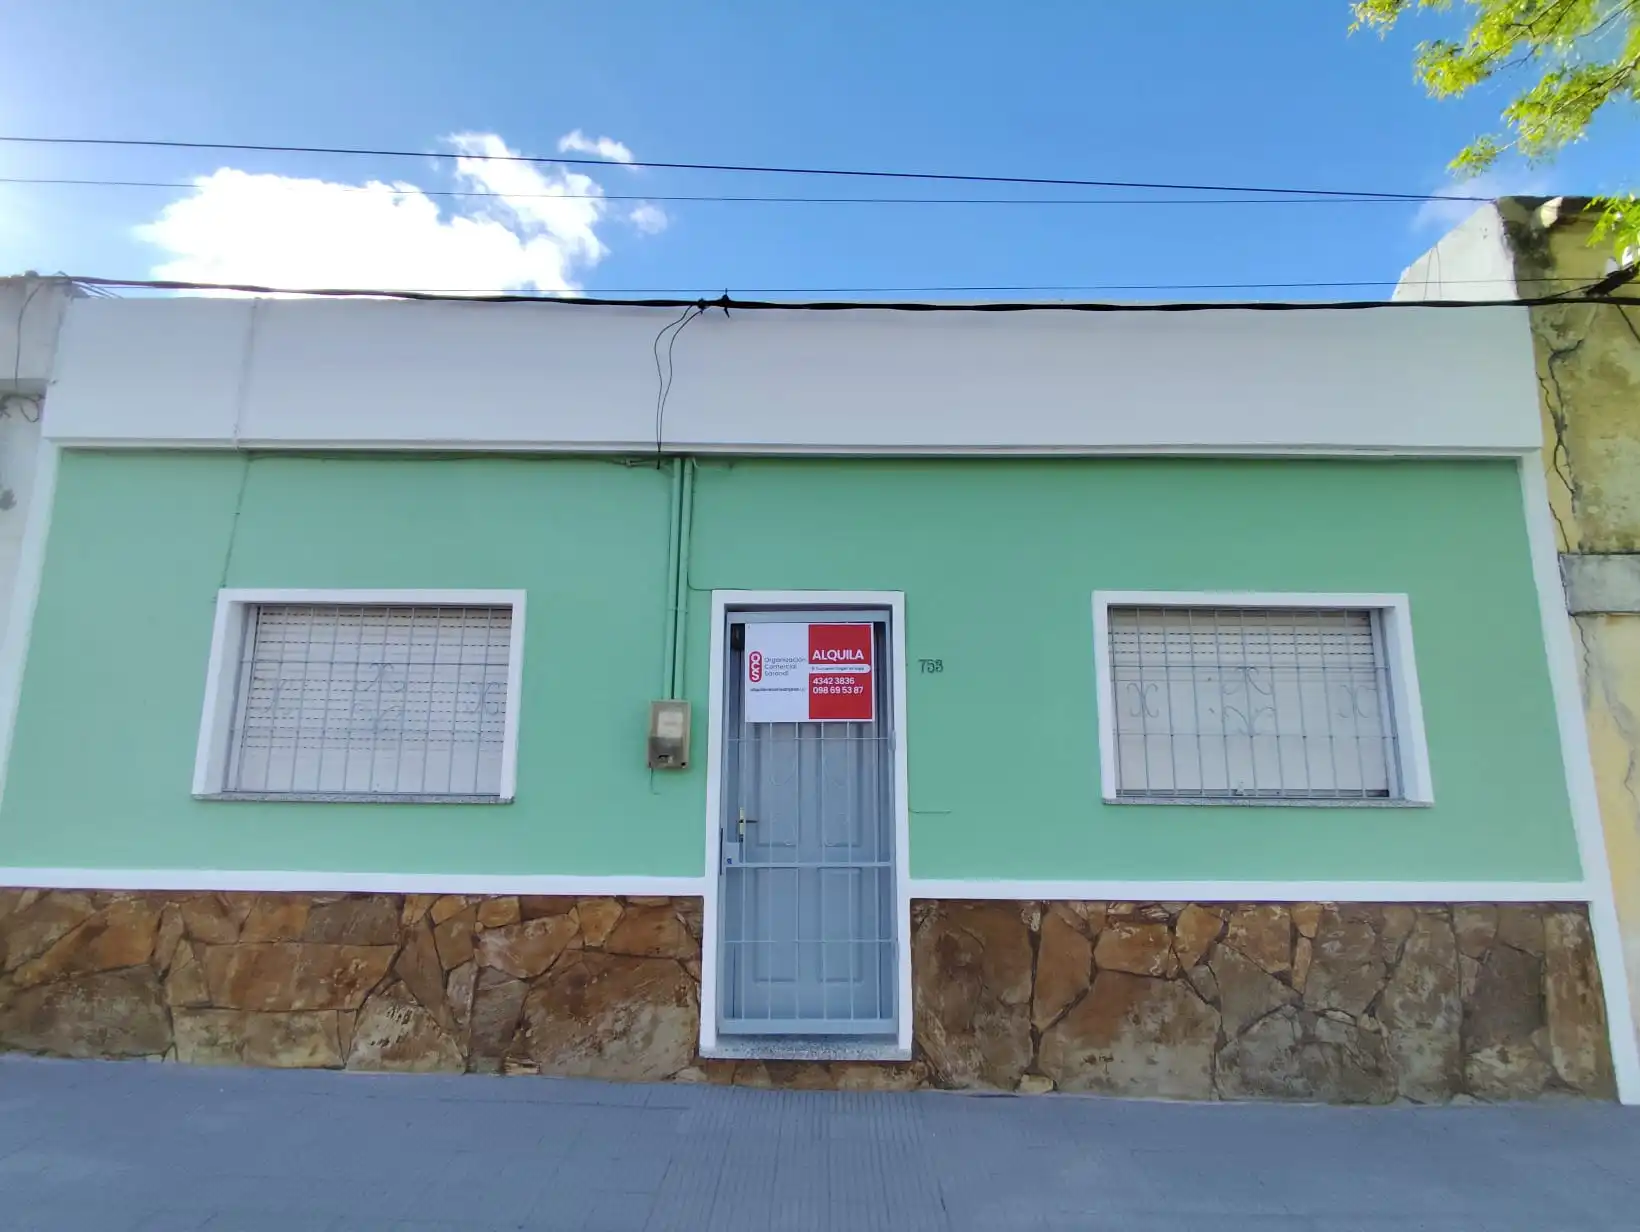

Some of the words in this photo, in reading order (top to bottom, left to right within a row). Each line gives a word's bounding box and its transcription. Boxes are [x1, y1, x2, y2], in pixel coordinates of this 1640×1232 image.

[812, 649, 864, 662] ALQUILA
[750, 653, 761, 681] OCS
[812, 677, 834, 685] 4342
[834, 677, 856, 685] 3836
[812, 686, 829, 694] 098
[830, 686, 841, 694] 69
[841, 686, 853, 694] 53
[853, 686, 864, 694] 87
